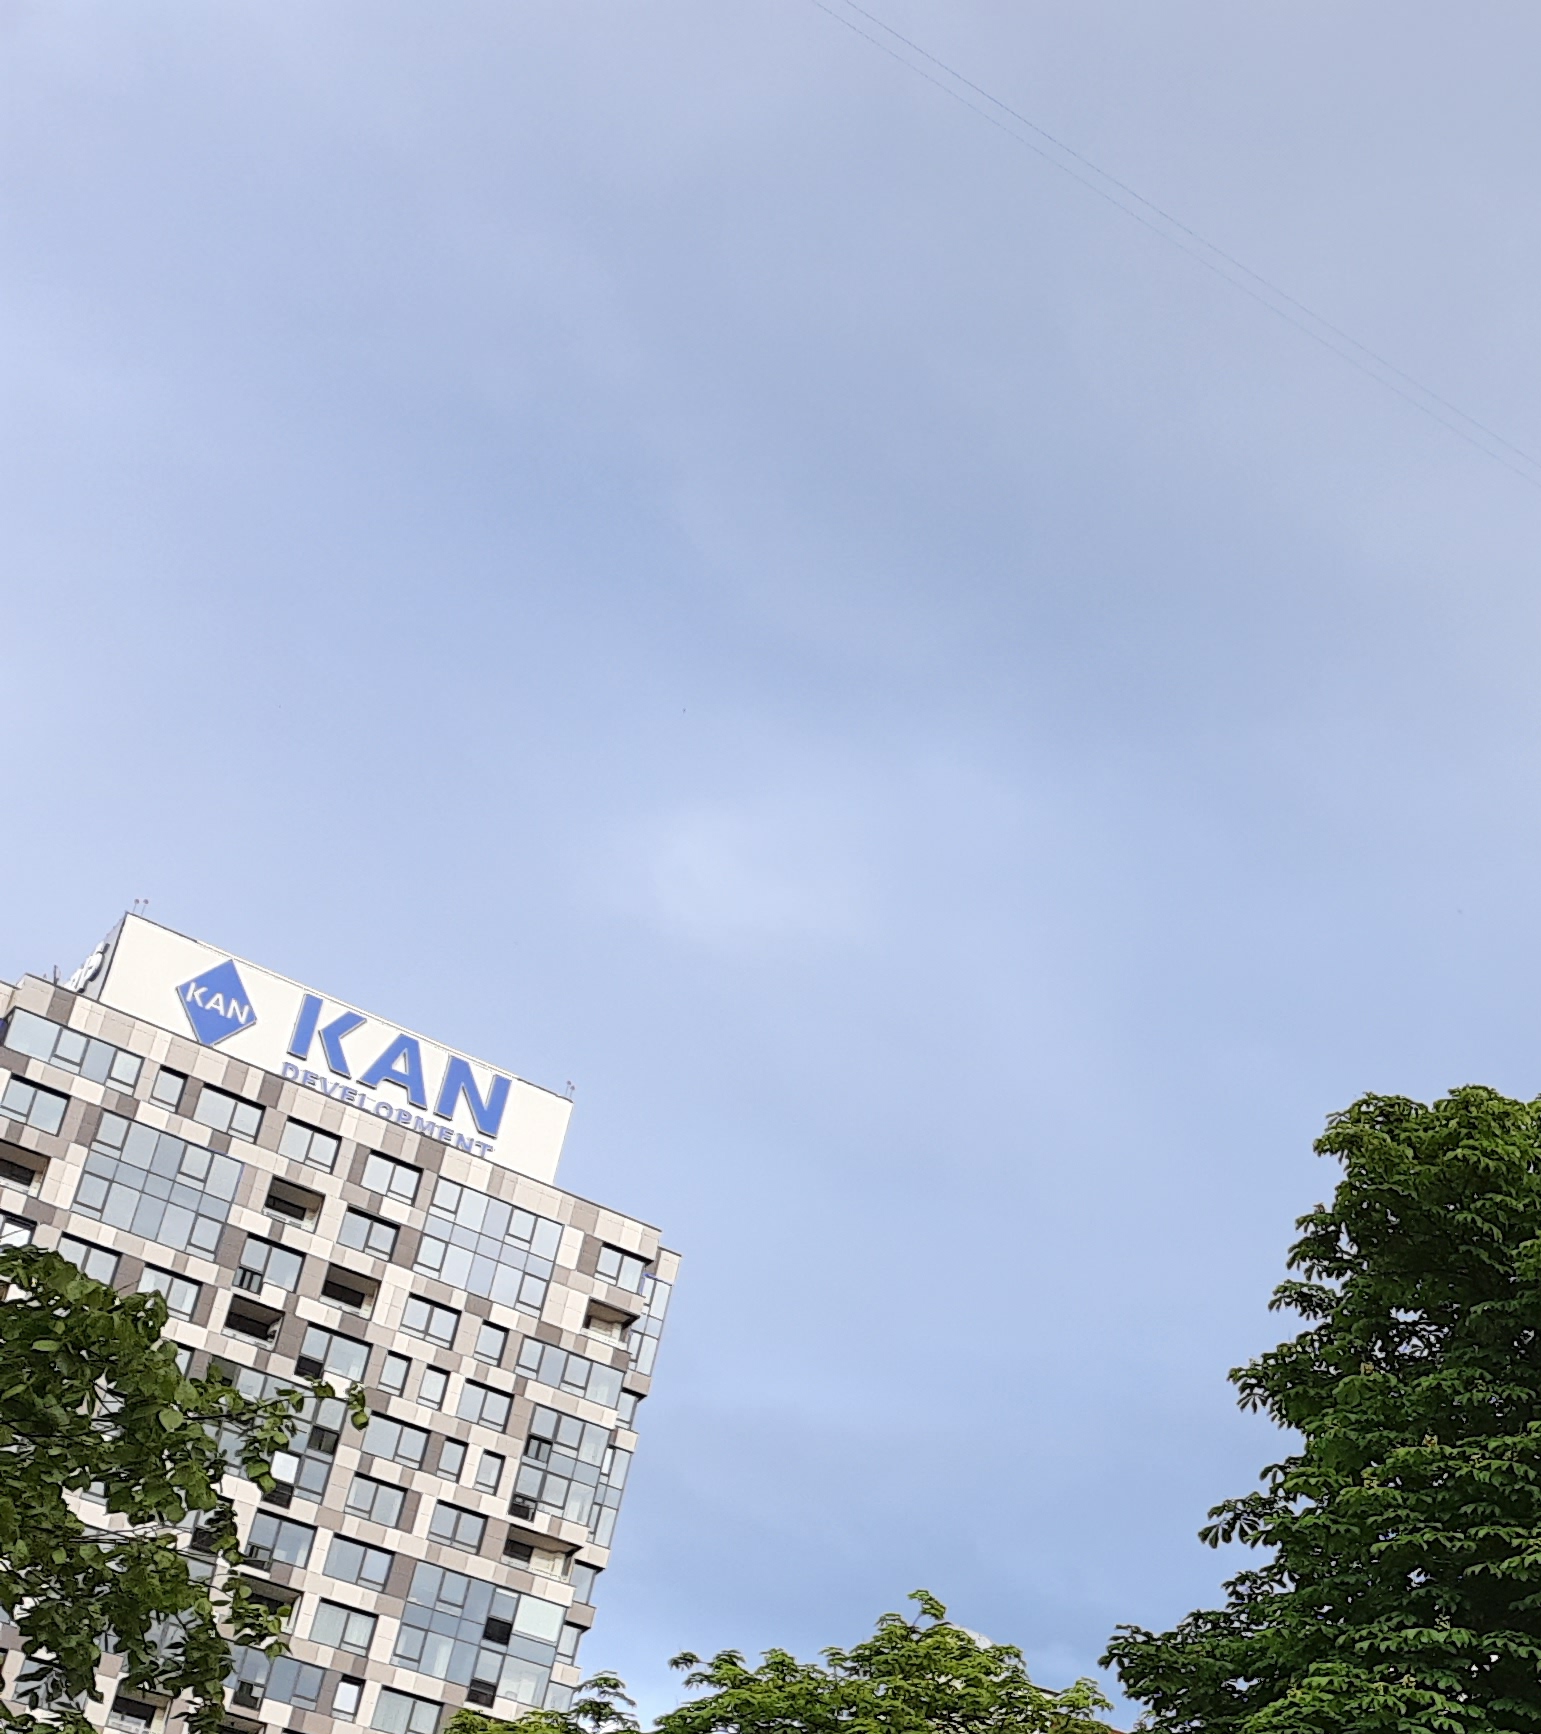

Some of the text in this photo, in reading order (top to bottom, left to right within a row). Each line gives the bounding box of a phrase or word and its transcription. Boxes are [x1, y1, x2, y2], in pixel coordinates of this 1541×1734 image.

[186, 981, 249, 1025] KAN
[281, 1061, 495, 1158] DEVELOPMENT
[287, 993, 512, 1139] KAN
